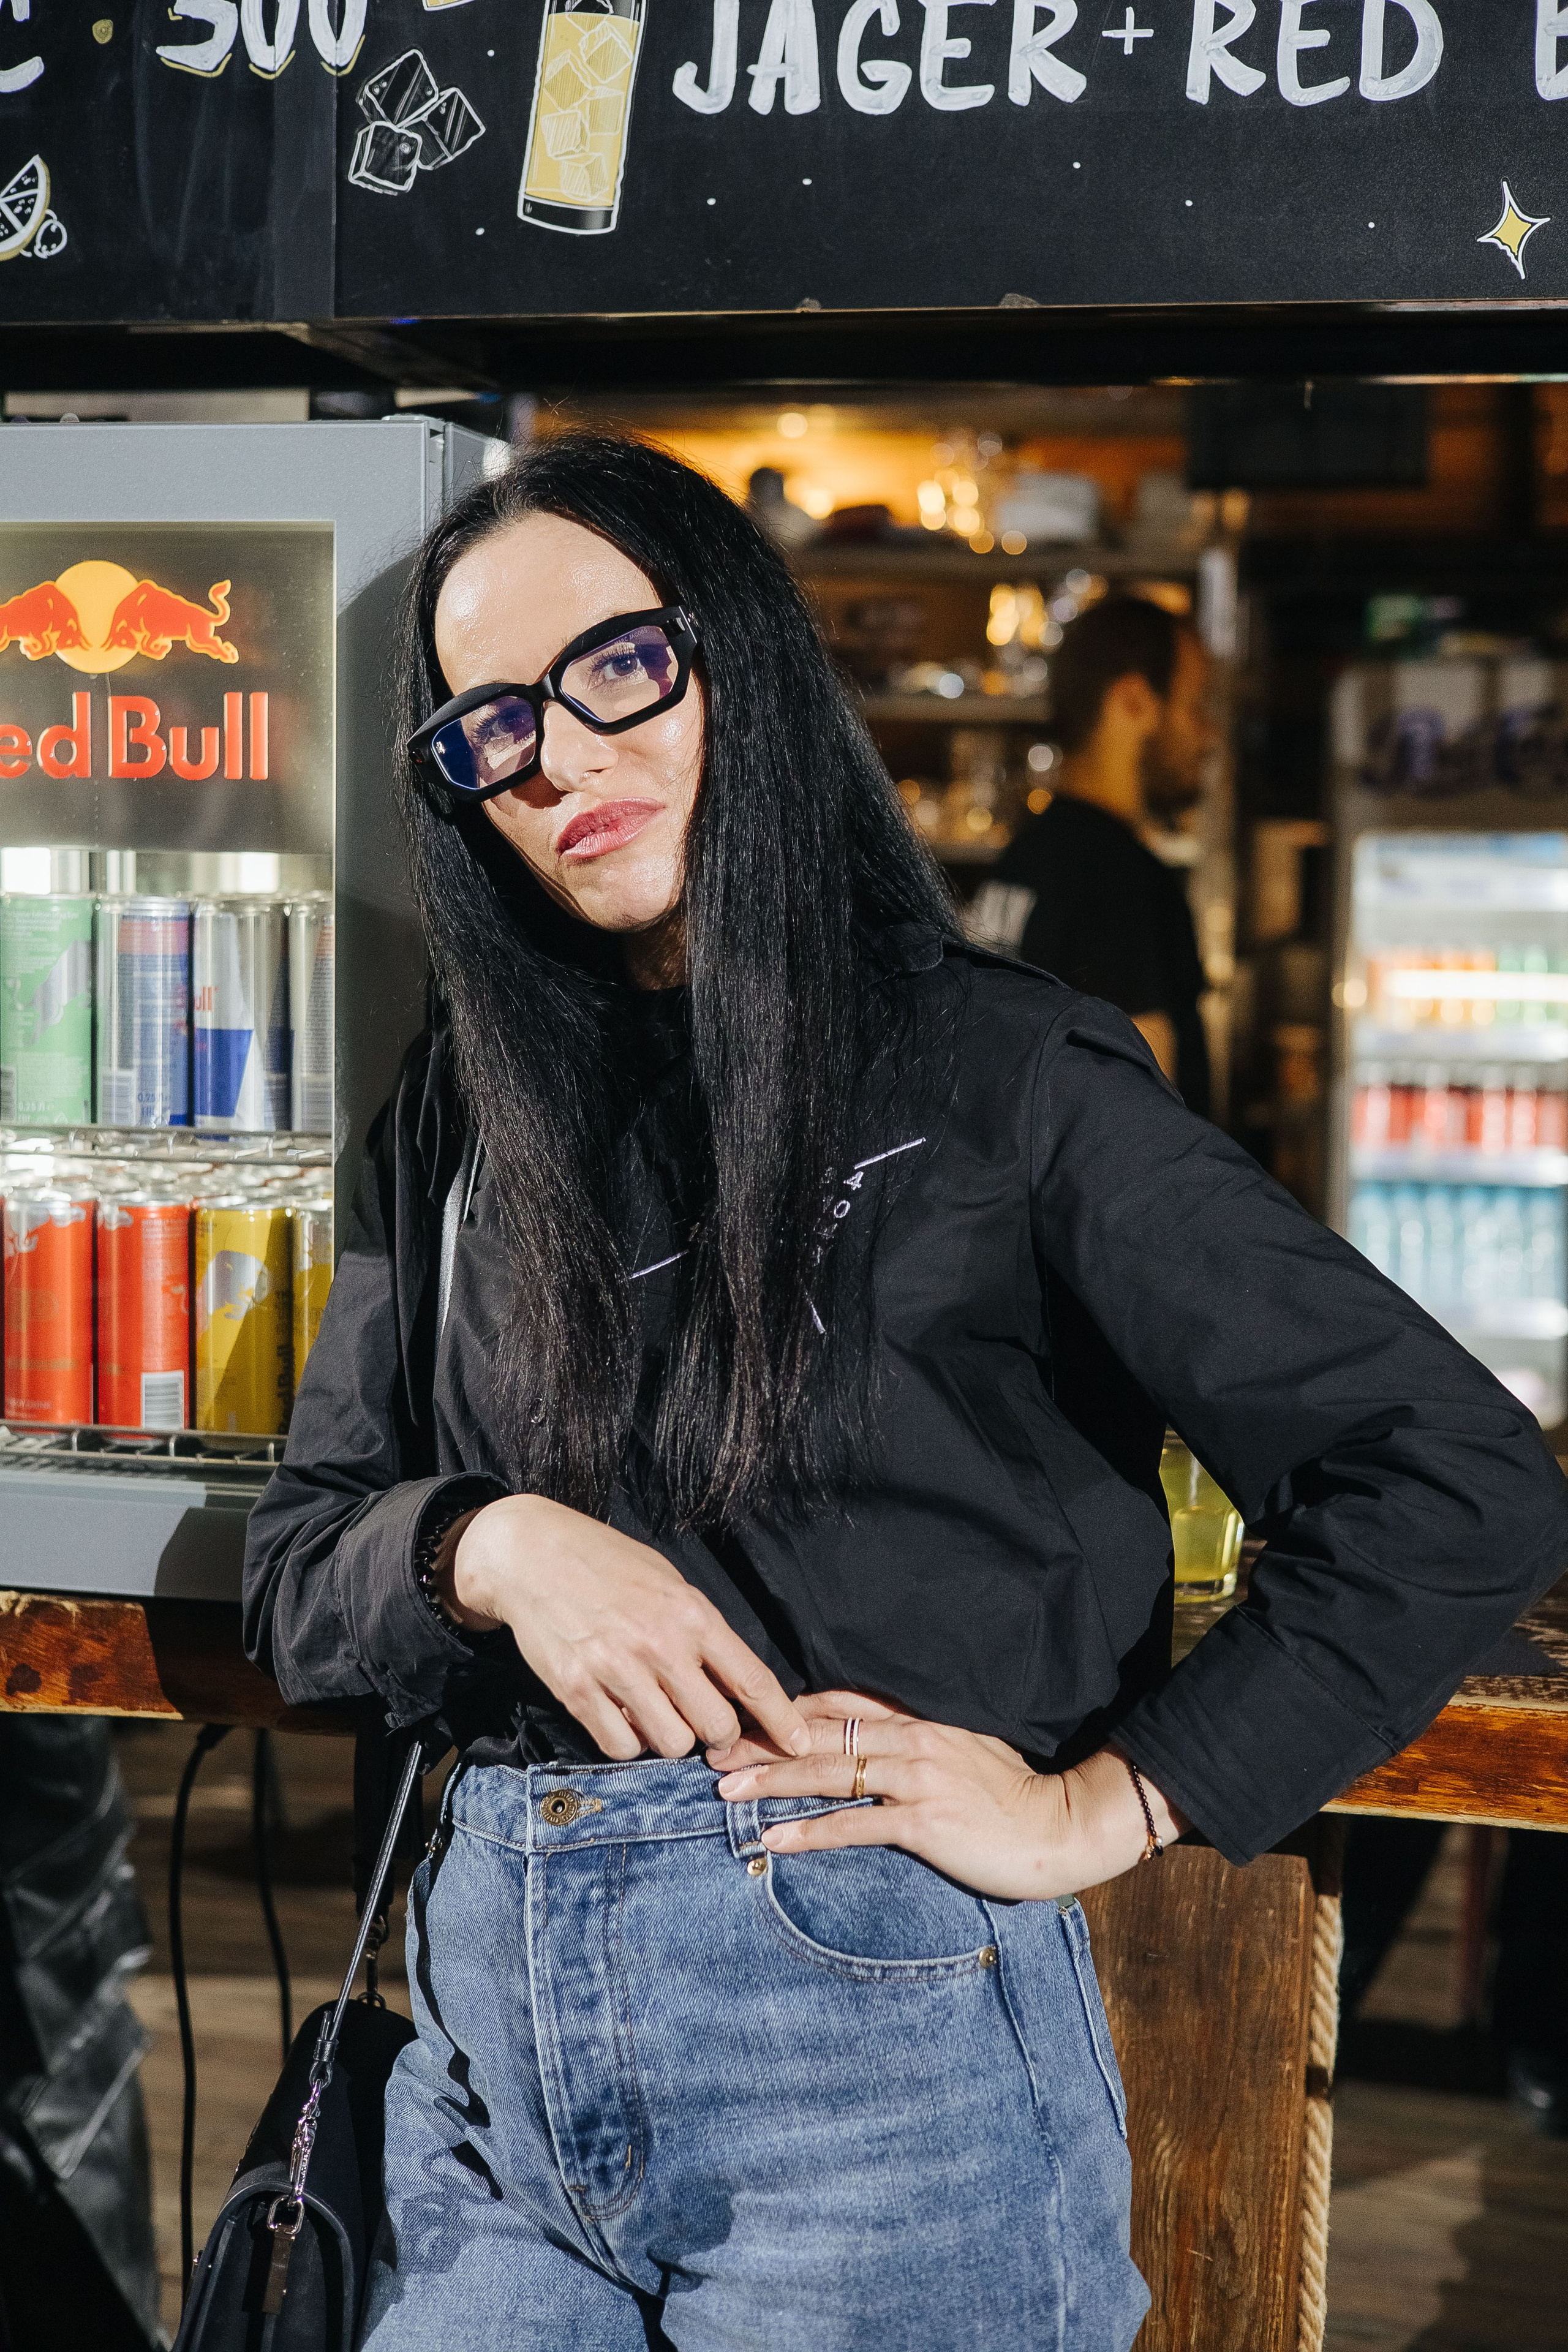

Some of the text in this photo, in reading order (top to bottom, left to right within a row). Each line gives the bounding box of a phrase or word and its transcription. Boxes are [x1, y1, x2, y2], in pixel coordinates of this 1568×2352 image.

[0, 692, 268, 780] ed Bull
[194, 985, 213, 1011] ull
